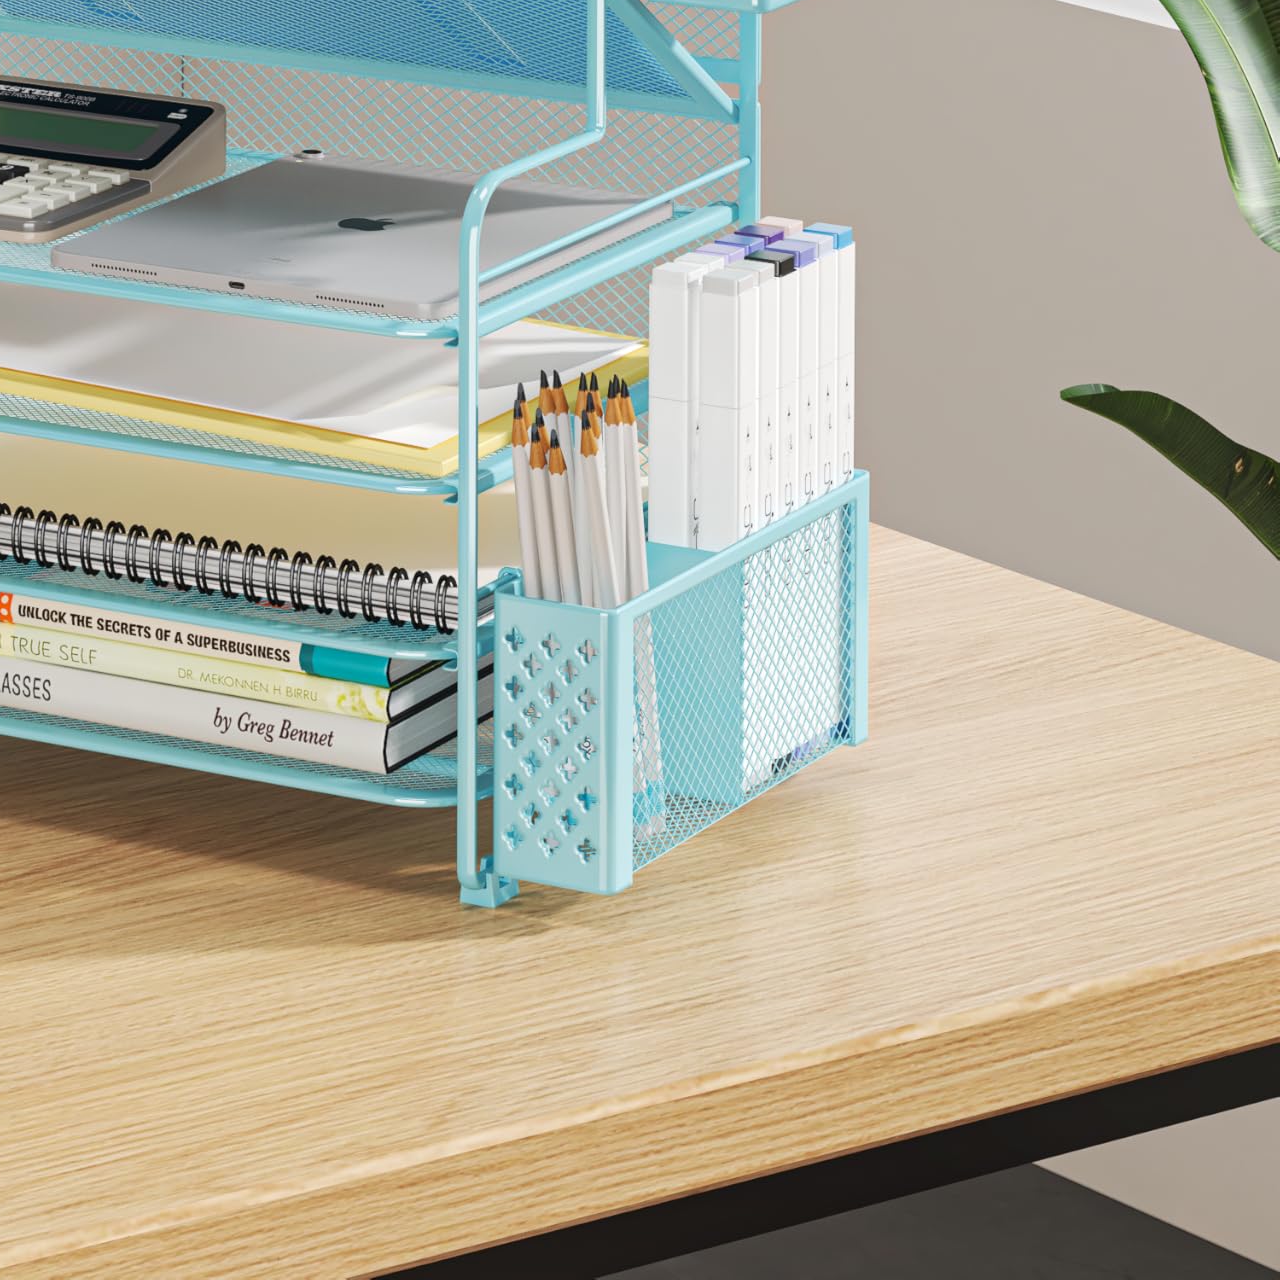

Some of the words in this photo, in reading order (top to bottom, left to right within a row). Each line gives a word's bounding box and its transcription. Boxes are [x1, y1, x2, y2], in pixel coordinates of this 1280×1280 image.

[10, 635, 51, 658] TRUE
[59, 644, 97, 665] SELF
[18, 604, 67, 625] UNLOCK
[70, 613, 93, 629] THE
[97, 618, 151, 639] SECRETS
[155, 629, 171, 642] OF
[174, 631, 183, 645] A
[187, 632, 291, 663] SUPERBUSINESS
[200, 671, 269, 694] MEKONNEN
[286, 686, 318, 702] BIRRU
[213, 707, 232, 733] by
[237, 712, 275, 742] Greg
[279, 719, 335, 747] Bennet
